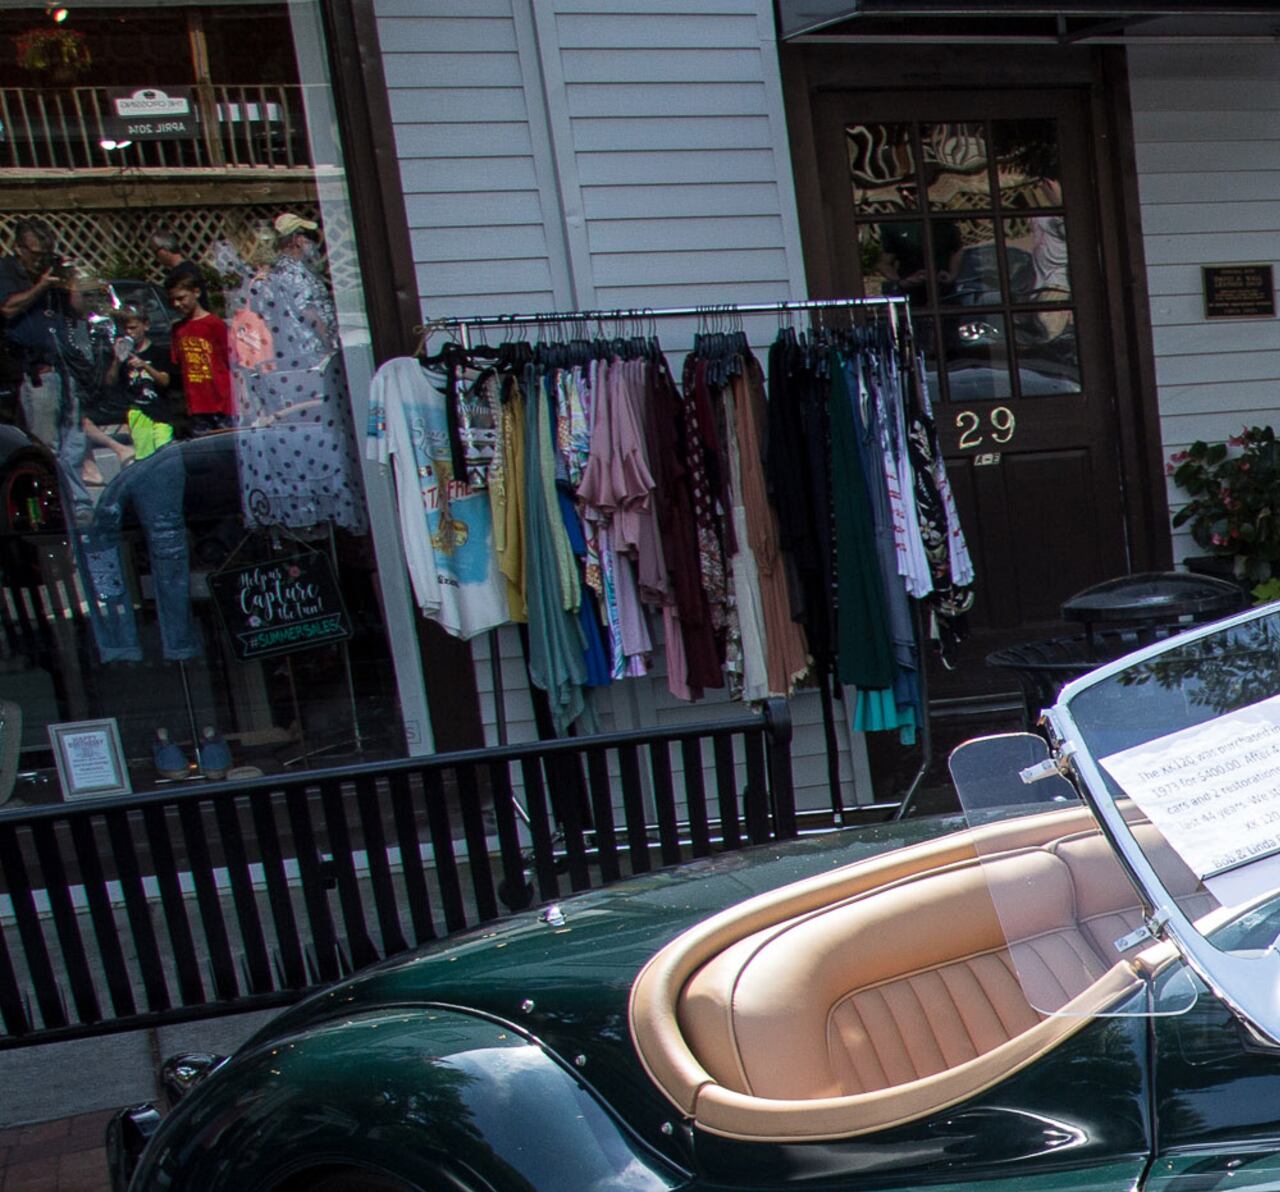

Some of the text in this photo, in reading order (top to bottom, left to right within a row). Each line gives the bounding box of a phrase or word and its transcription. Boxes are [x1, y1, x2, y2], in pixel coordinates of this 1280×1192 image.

[955, 406, 1016, 450] 29
[240, 579, 320, 622] Capture
[1152, 782, 1178, 797] 1973
[1178, 776, 1196, 786] for
[1244, 751, 1270, 763] After
[1167, 801, 1188, 812] cars
[1191, 793, 1210, 805] and
[1221, 767, 1280, 792] restorations
[1247, 840, 1278, 854] Linda
